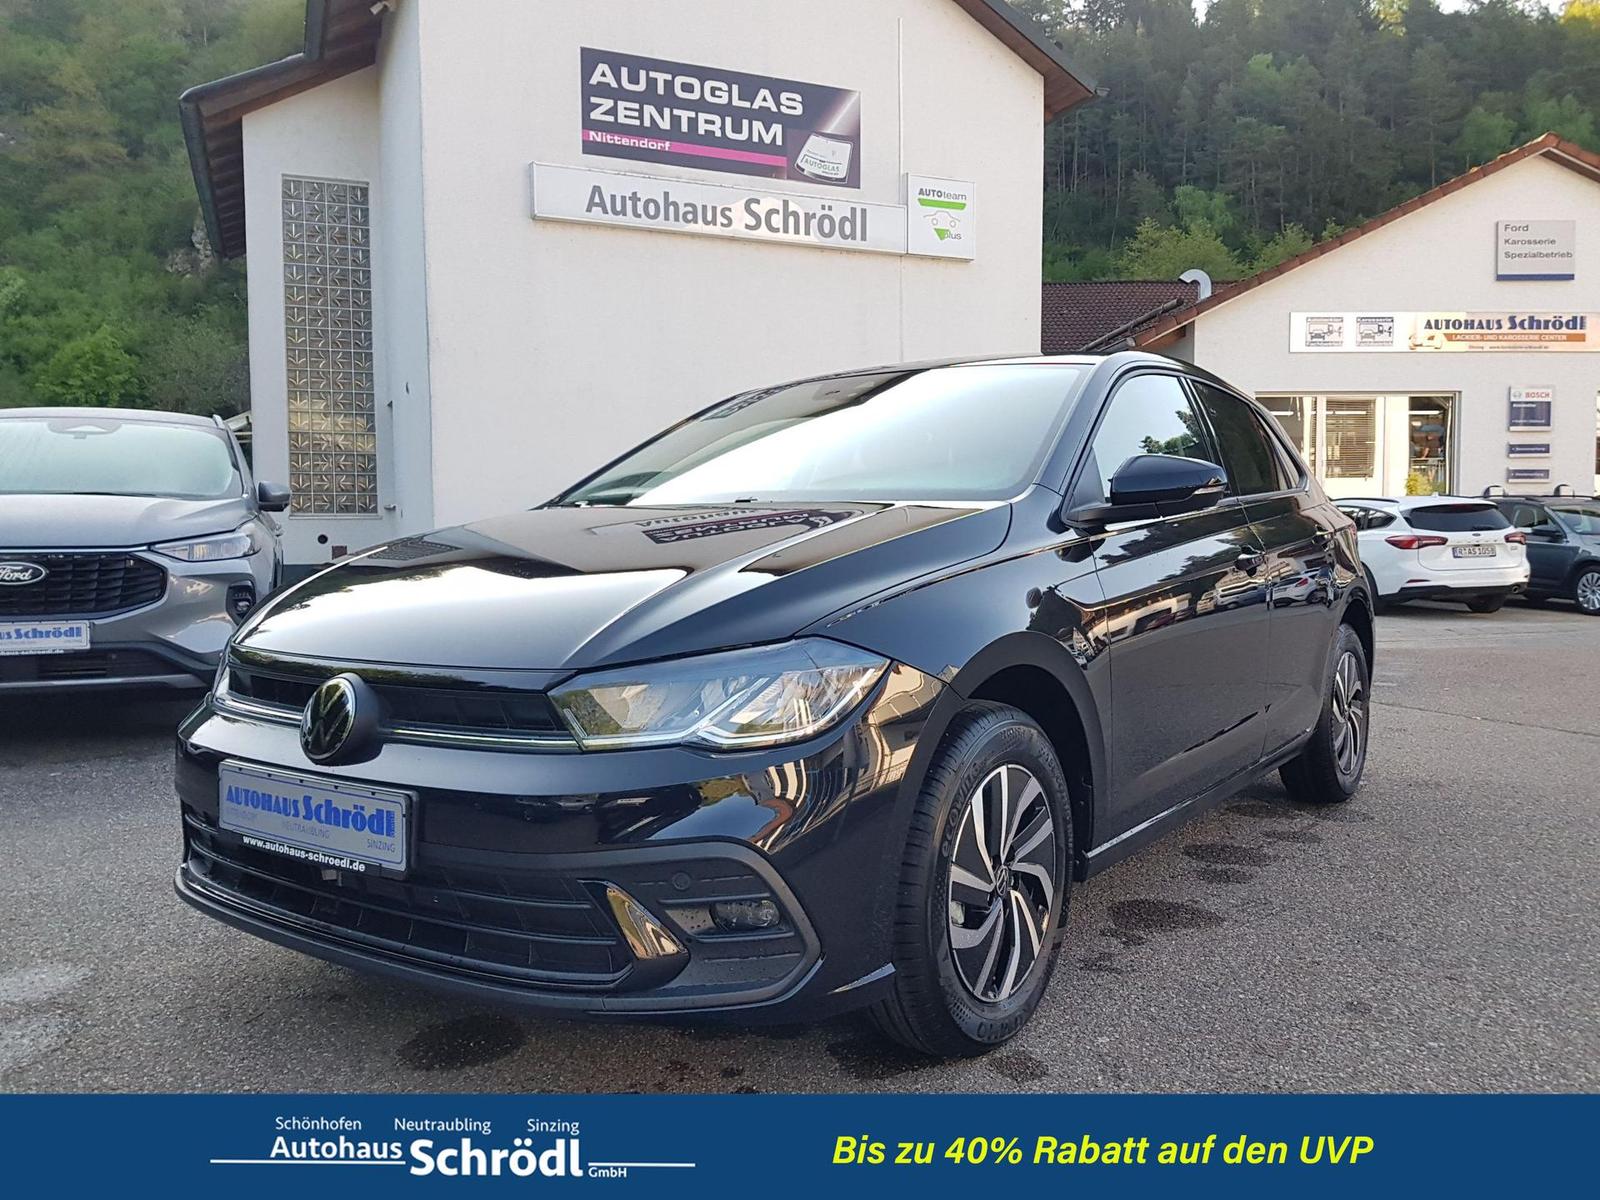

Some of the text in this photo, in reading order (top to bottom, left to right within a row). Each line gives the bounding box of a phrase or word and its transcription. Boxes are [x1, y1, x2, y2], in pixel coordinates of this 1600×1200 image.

[588, 62, 804, 116] AUTOGLAS
[588, 96, 784, 147] ZENTRUM
[588, 130, 672, 152] Nittendorf
[804, 158, 840, 172] AUTOGLAS
[585, 184, 868, 242] Autohaus Schrödl
[1504, 223, 1529, 232] Ford
[1504, 237, 1557, 246] Karosserie
[1504, 250, 1573, 260] Spezialbetrieb
[1424, 314, 1586, 331] AUTOHAUS Schrödl
[1541, 334, 1567, 342] CENTER
[1524, 391, 1551, 399] BOSCH
[14, 627, 82, 640] Schrödl
[226, 785, 395, 838] AUTOHAUS Schrödl
[367, 838, 396, 853] SINZING
[243, 835, 366, 872] www.autohaus-schroedl.de
